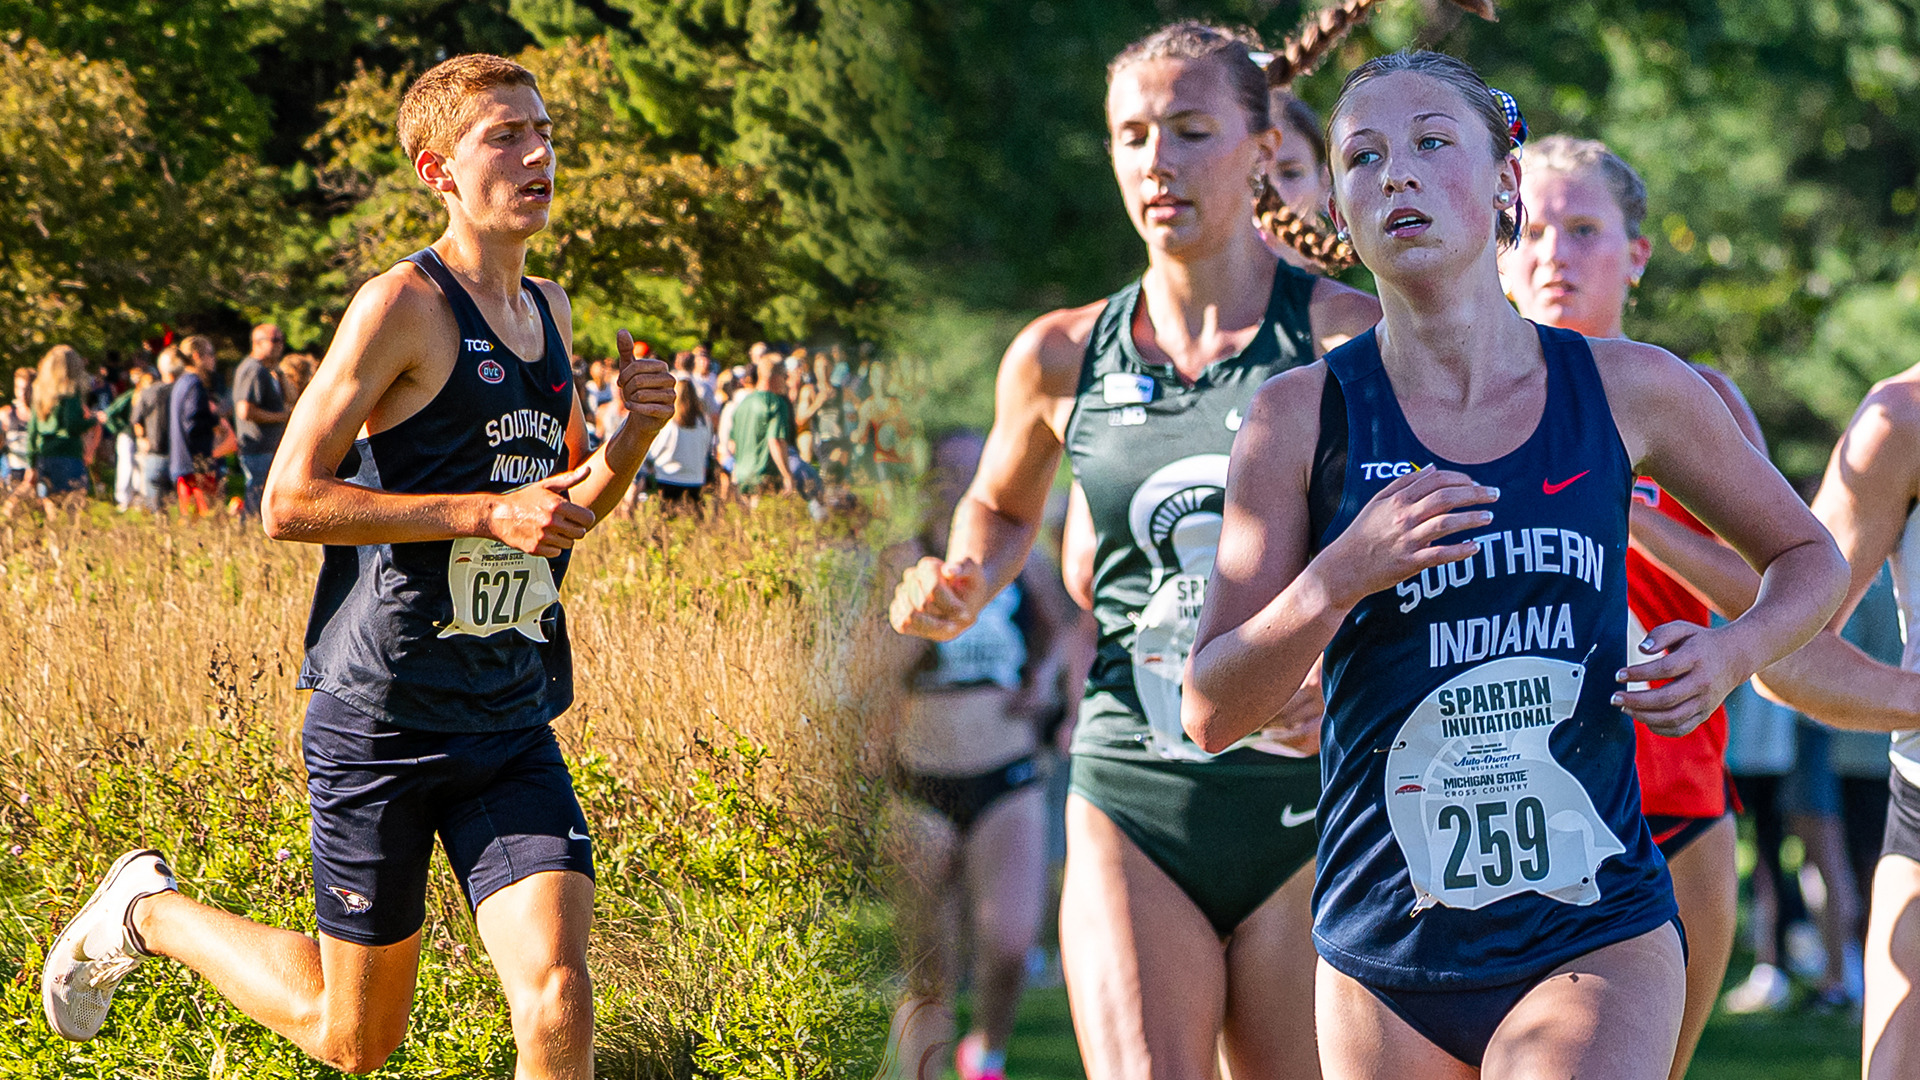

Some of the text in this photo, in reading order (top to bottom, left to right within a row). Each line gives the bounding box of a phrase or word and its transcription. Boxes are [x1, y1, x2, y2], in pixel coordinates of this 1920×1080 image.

[465, 339, 490, 351] TCG
[485, 409, 567, 455] SOUTHERN
[490, 454, 555, 484] INDIAN
[1361, 462, 1411, 480] TCG
[1397, 528, 1604, 614] SOUTHERN
[472, 570, 530, 626] 627
[1429, 603, 1575, 668] INDIANA
[1438, 675, 1552, 716] SPARTAN
[1441, 708, 1556, 738] INVITATIONAL
[1454, 753, 1521, 767] Auto-Owners
[1467, 763, 1509, 772] INSURANCE
[1443, 773, 1495, 790] MICHIGAN
[1496, 770, 1528, 785] STATE
[1444, 783, 1528, 798] CROSS COUNTRY
[1438, 797, 1550, 890] 259
